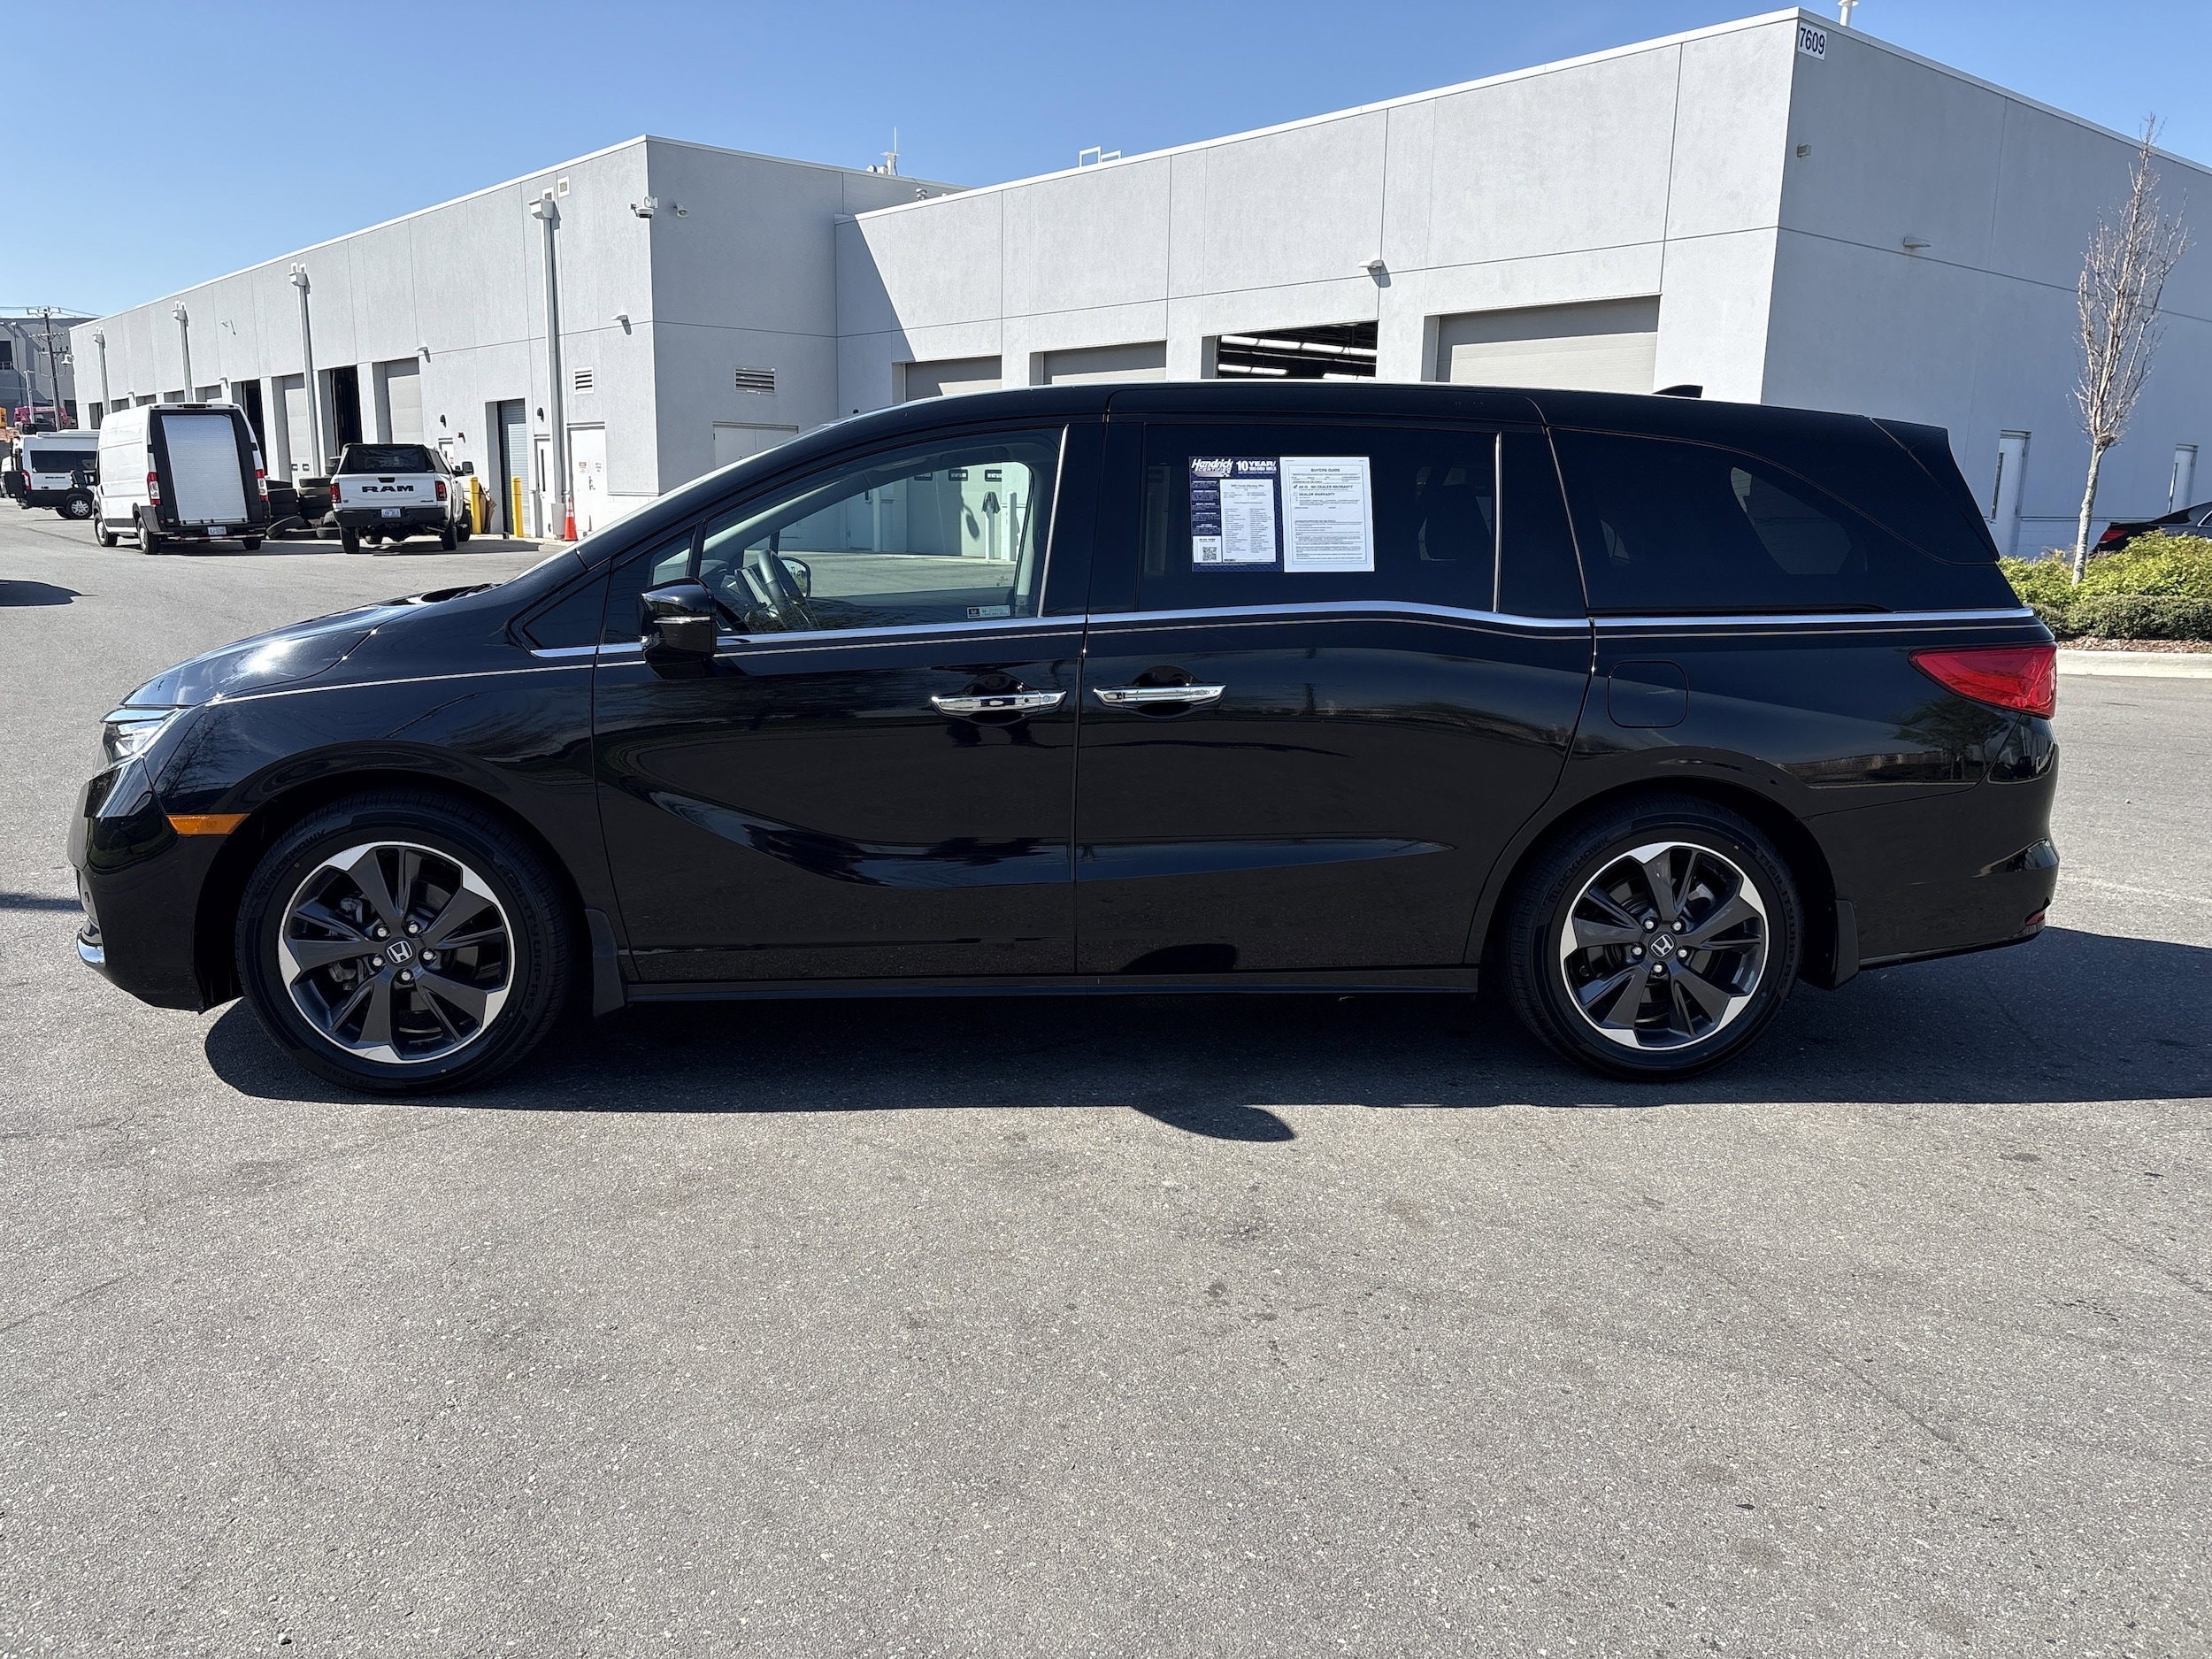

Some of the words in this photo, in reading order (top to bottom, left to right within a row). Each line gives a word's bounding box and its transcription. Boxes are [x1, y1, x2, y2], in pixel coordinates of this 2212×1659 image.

[1800, 27, 1825, 55] 7609
[1191, 458, 1233, 472] Hendrick
[1236, 460, 1249, 472] 10
[1548, 836, 1610, 903] BLACKHAWK
[1760, 853, 1794, 921] AGILITY
[497, 863, 540, 936] AGILITY
